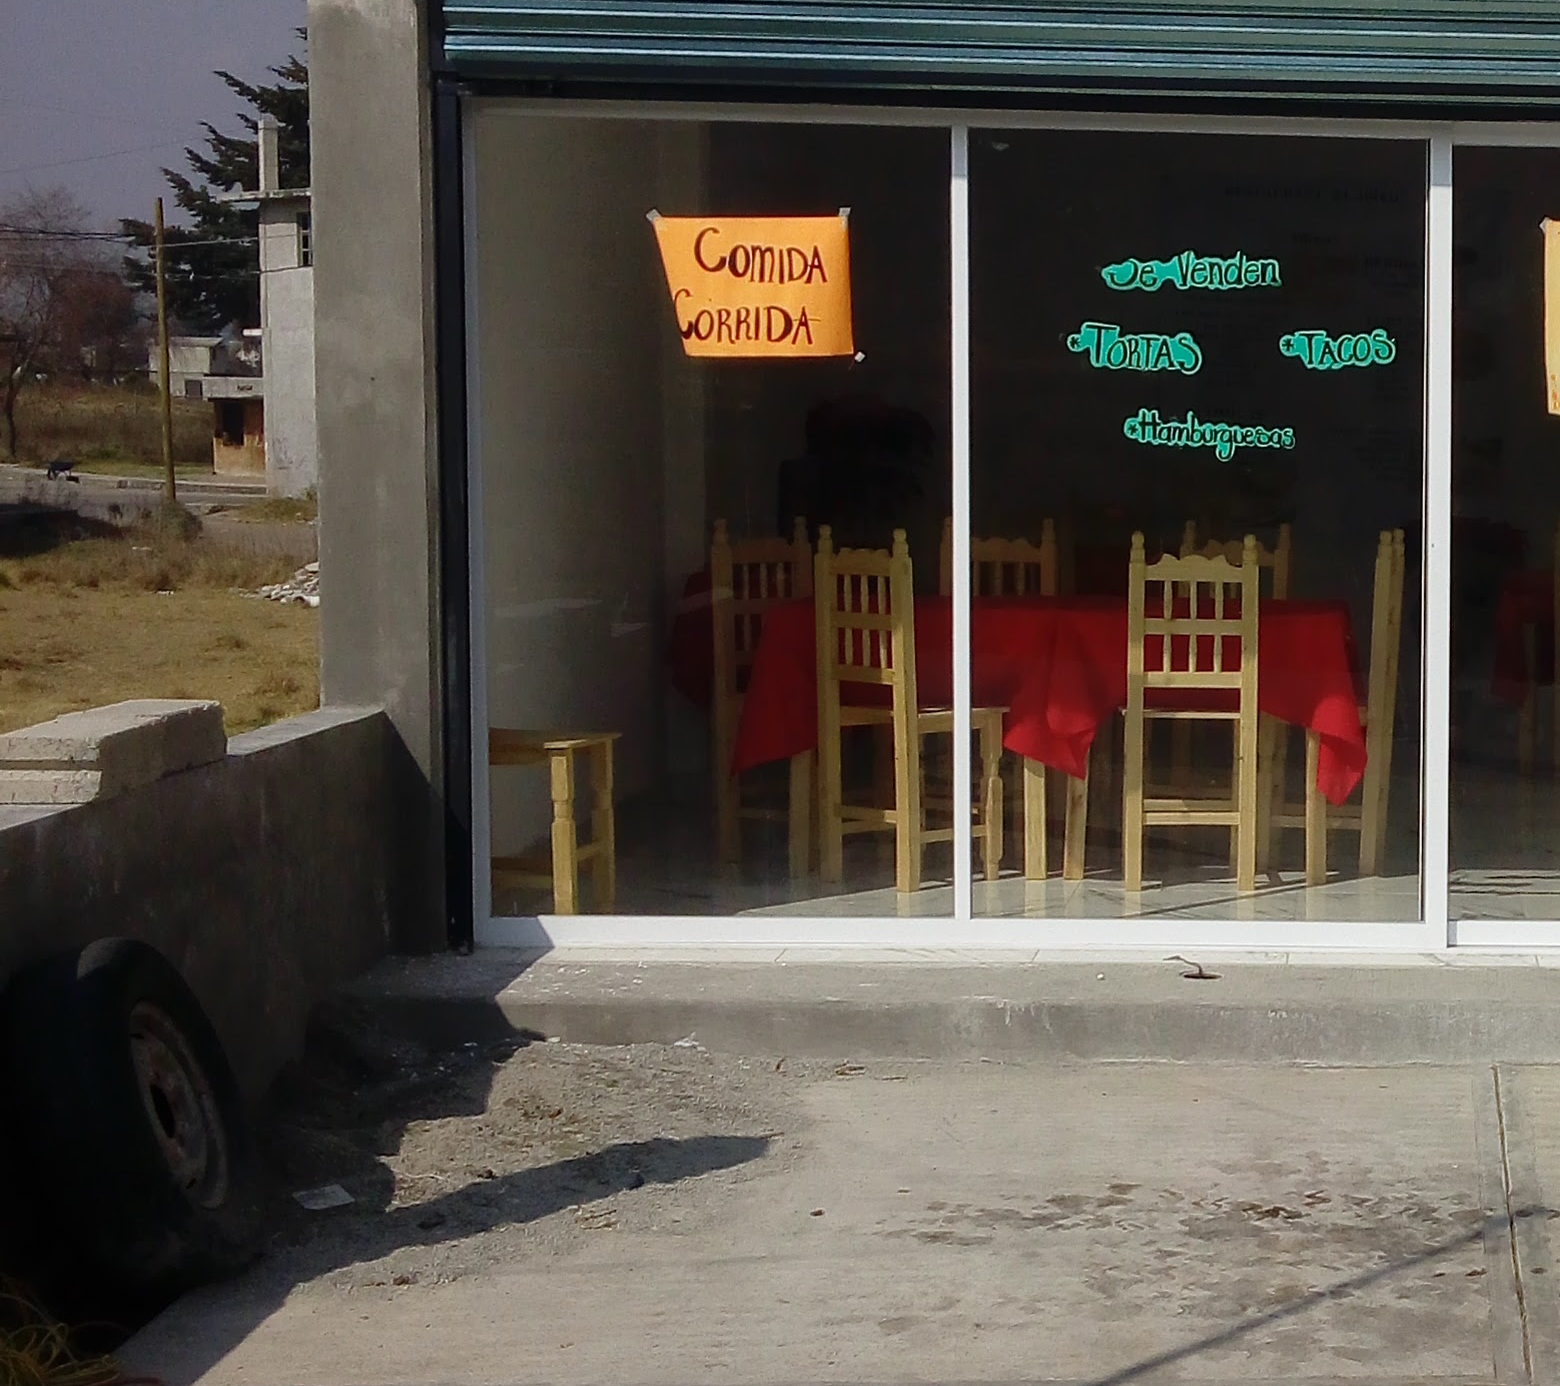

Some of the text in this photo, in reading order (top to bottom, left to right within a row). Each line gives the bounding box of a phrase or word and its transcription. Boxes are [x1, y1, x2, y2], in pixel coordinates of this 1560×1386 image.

[694, 227, 828, 284] COMIDA
[1174, 251, 1280, 288] Venden
[673, 288, 815, 345] CORRIDA
